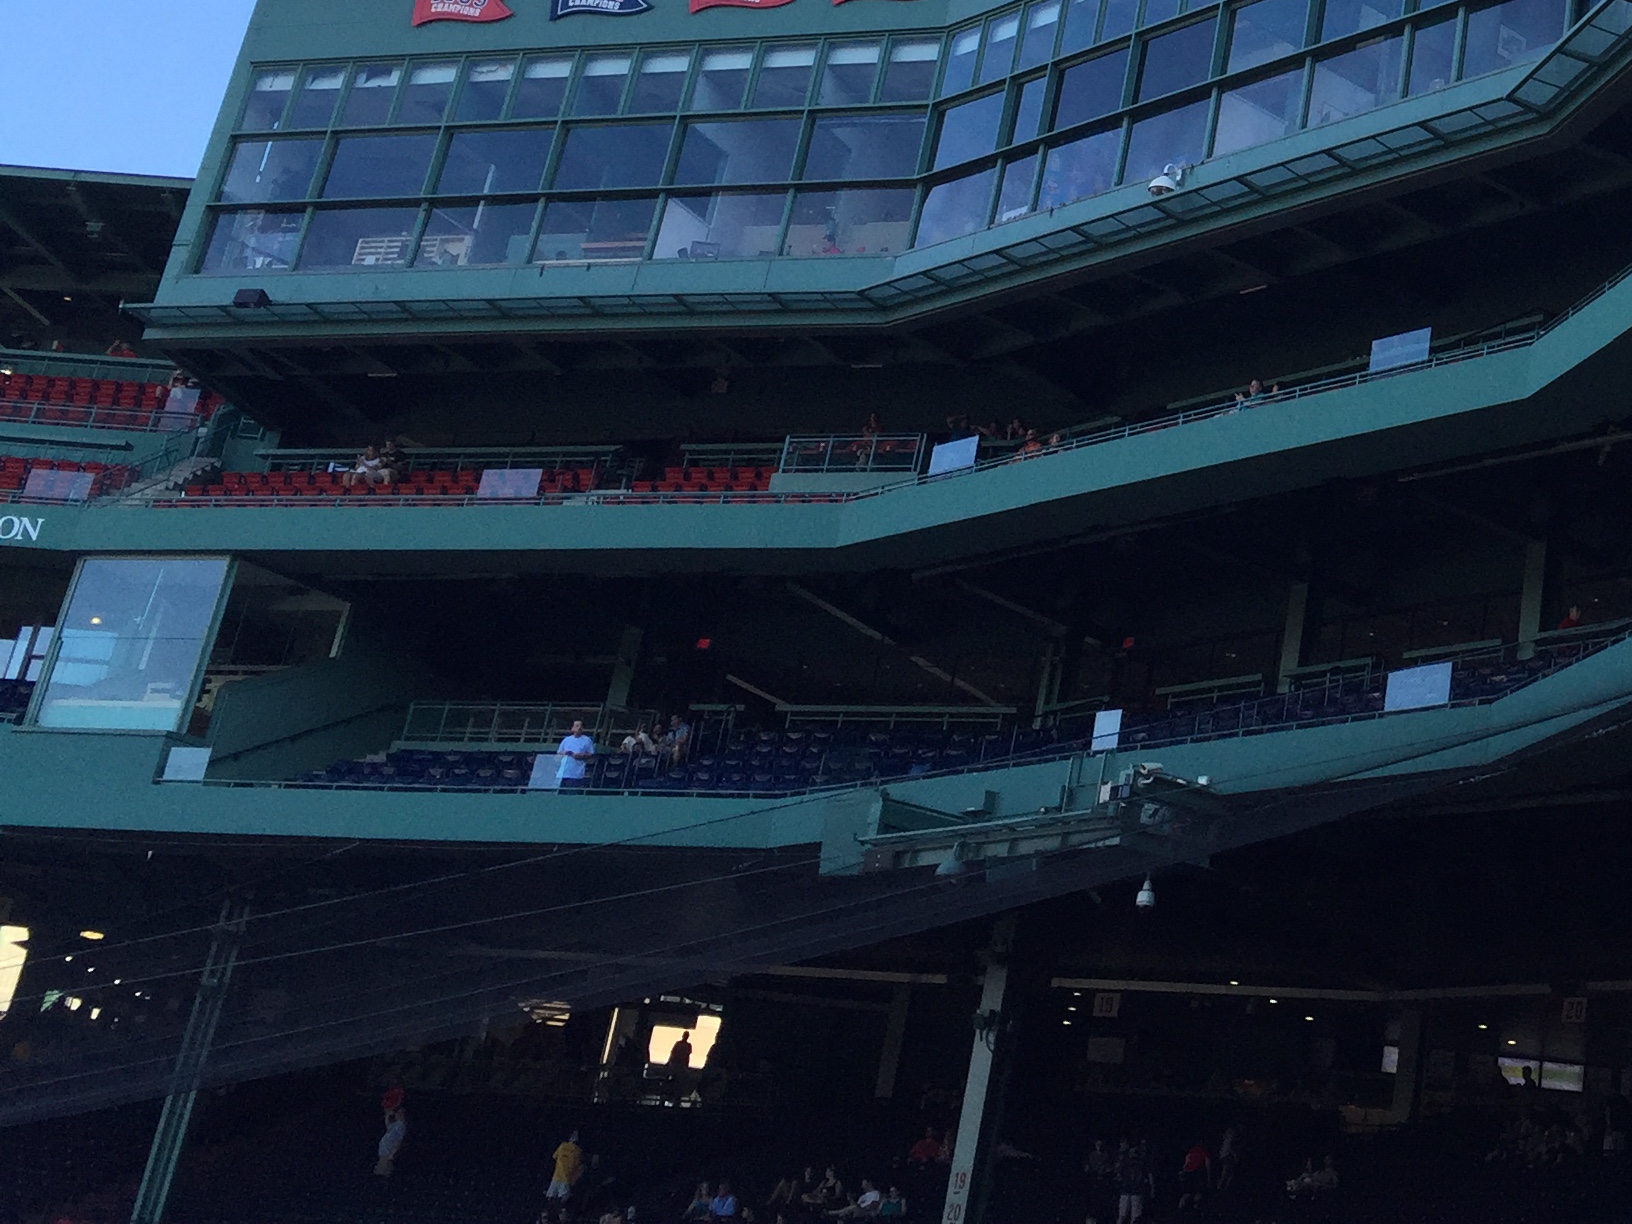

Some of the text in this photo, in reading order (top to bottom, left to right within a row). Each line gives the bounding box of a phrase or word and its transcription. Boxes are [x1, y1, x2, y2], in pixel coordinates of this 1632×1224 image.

[431, 3, 481, 17] CHAMPIONS
[1100, 996, 1114, 1013] 19
[1565, 1000, 1583, 1020] 20
[954, 1172, 967, 1190] 19
[947, 1203, 962, 1221] 20
